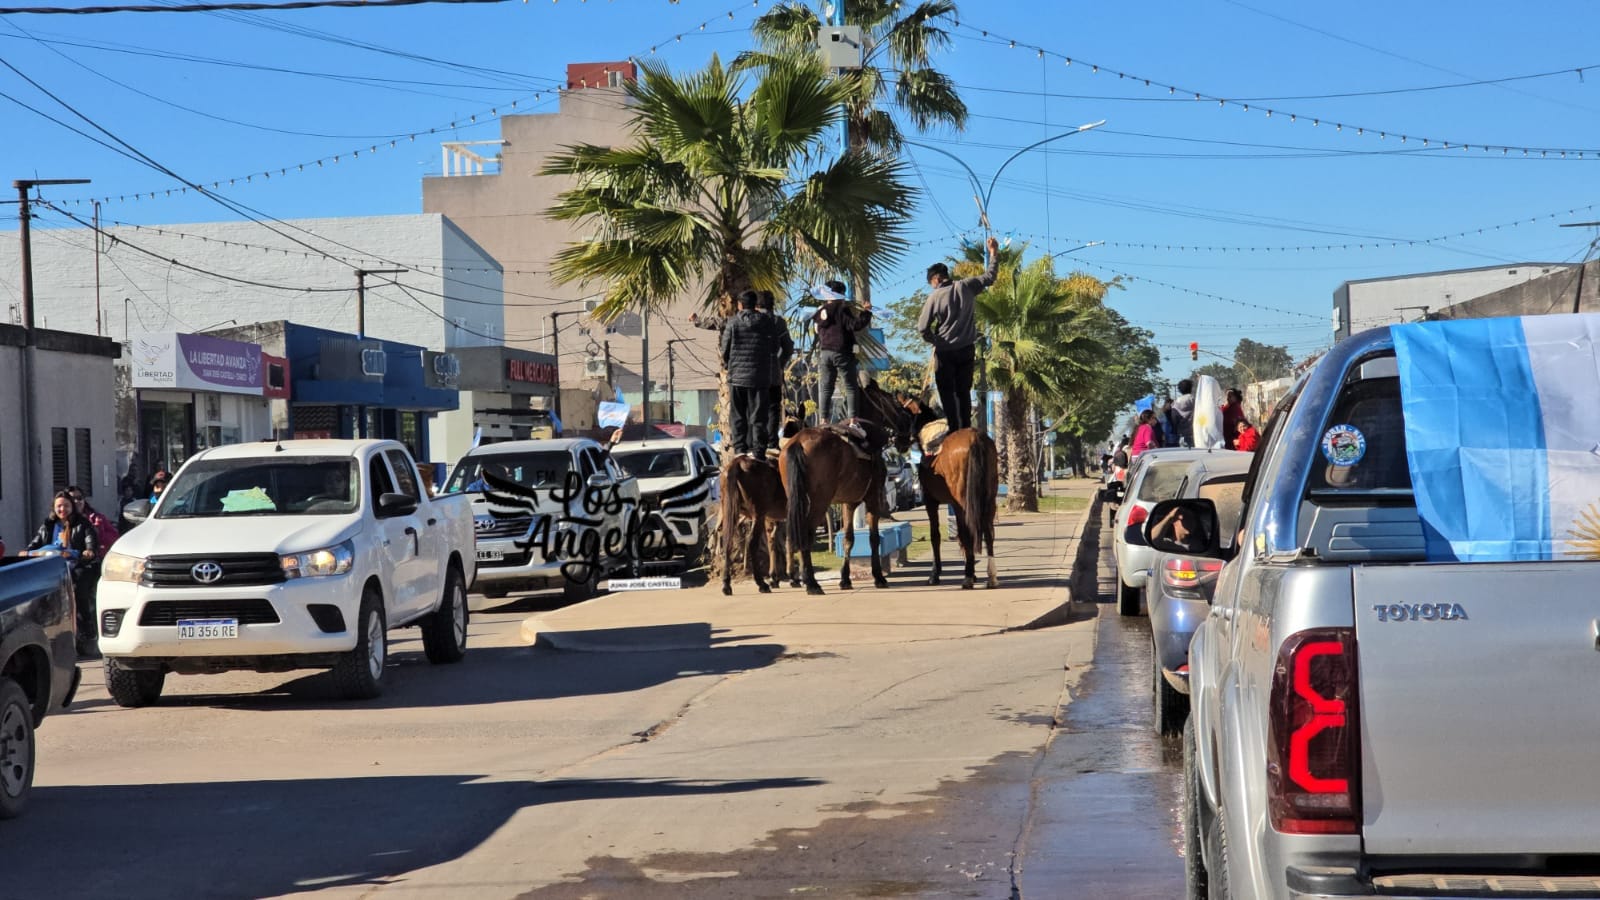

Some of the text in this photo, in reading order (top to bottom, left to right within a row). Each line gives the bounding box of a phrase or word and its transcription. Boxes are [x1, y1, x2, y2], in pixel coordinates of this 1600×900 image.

[190, 351, 247, 370] LA LIBERTAD AVANZA
[510, 359, 524, 381] FULL
[524, 361, 552, 384] MERCADO
[1322, 424, 1347, 444] WORLD
[1374, 603, 1469, 622] TOYOTA
[181, 625, 236, 637] AD 356 RE
